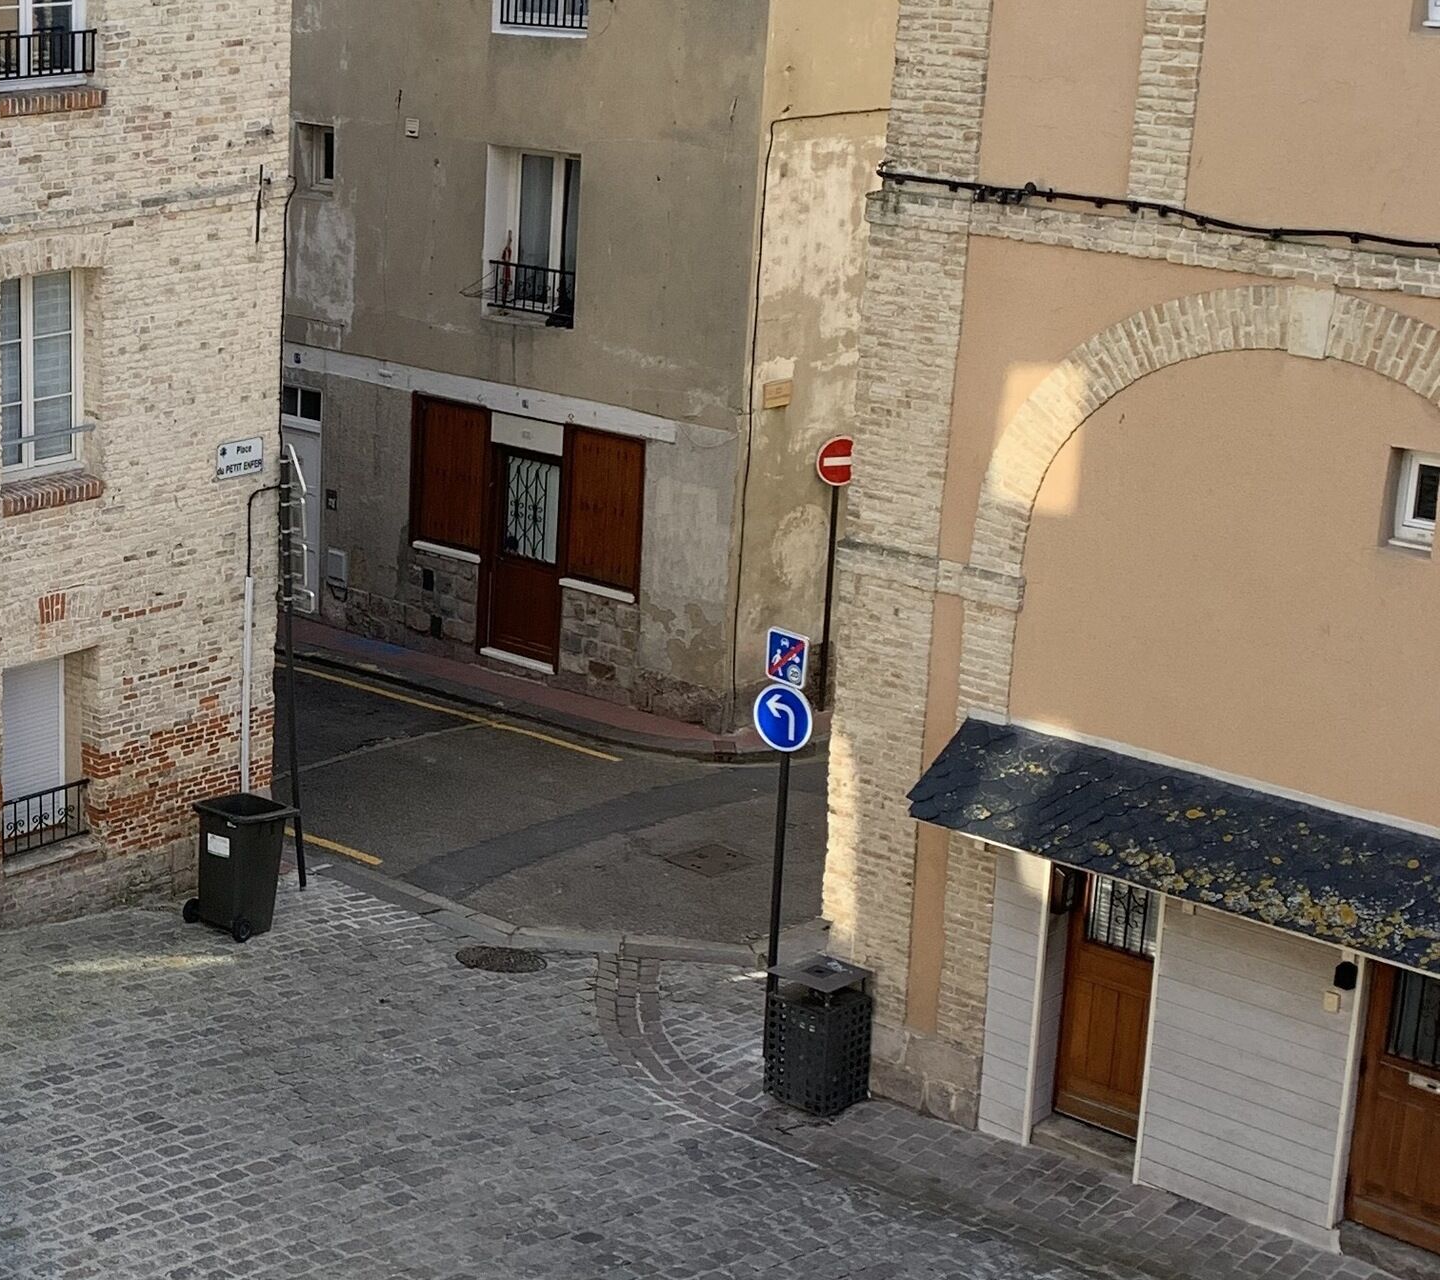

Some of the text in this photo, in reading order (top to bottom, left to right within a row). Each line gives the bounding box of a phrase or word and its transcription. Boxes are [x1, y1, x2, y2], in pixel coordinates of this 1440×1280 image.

[237, 445, 252, 455] Place
[216, 459, 263, 475] du PETIT ENFER
